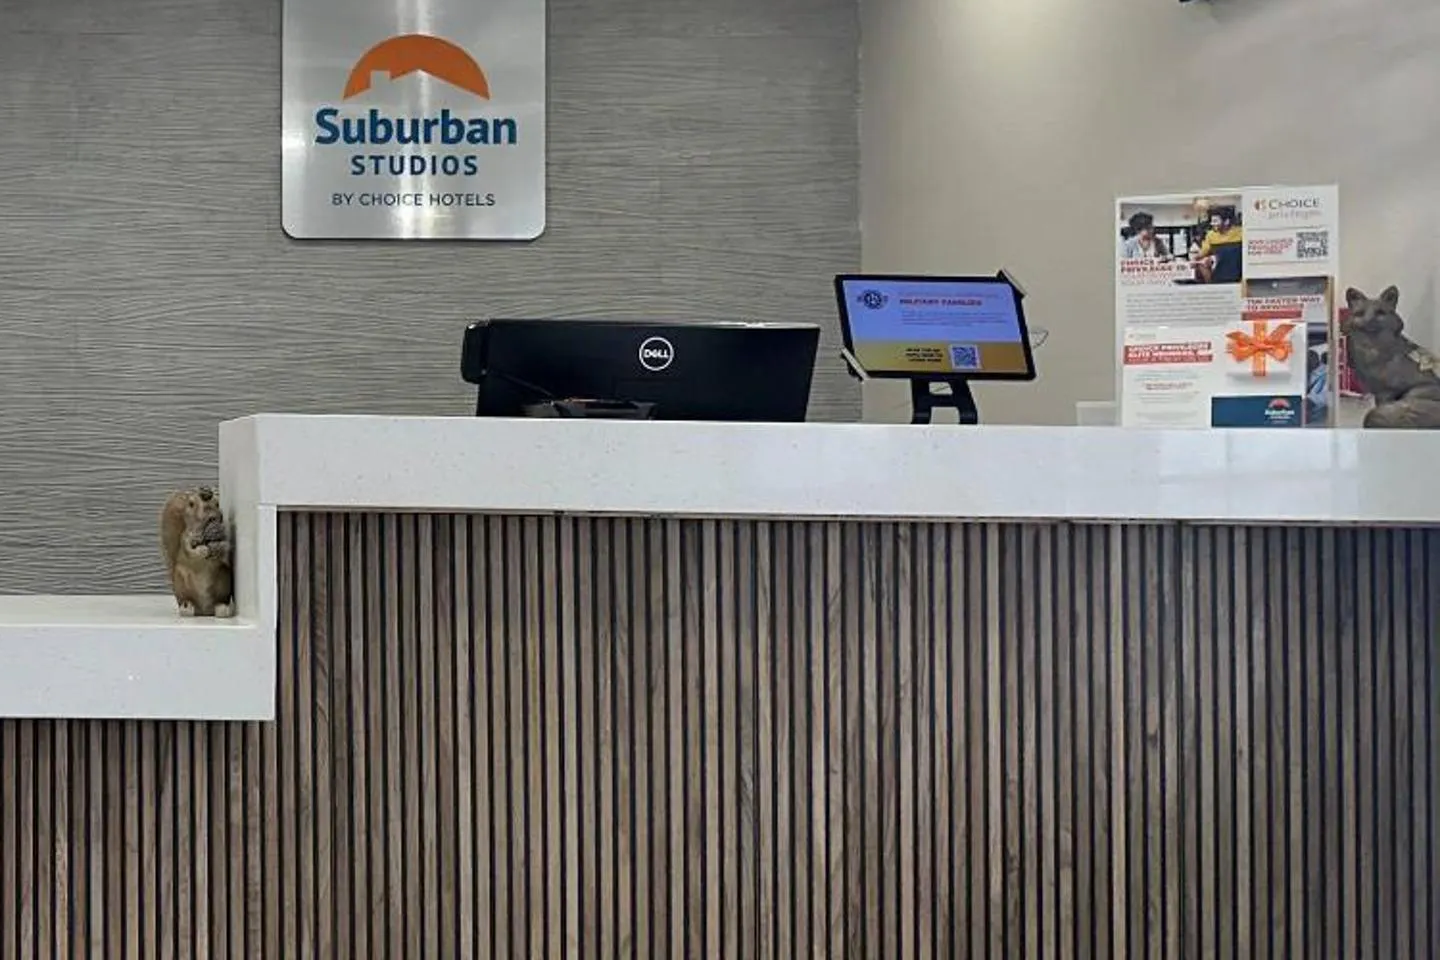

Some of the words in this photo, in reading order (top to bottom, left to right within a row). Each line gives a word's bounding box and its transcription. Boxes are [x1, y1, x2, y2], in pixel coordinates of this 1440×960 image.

[315, 108, 517, 145] Suburban
[351, 155, 478, 176] STUDIOS
[332, 193, 354, 207] BY
[359, 193, 423, 207] CHOICE
[429, 193, 496, 207] HOTELS
[644, 348, 669, 358] DELL
